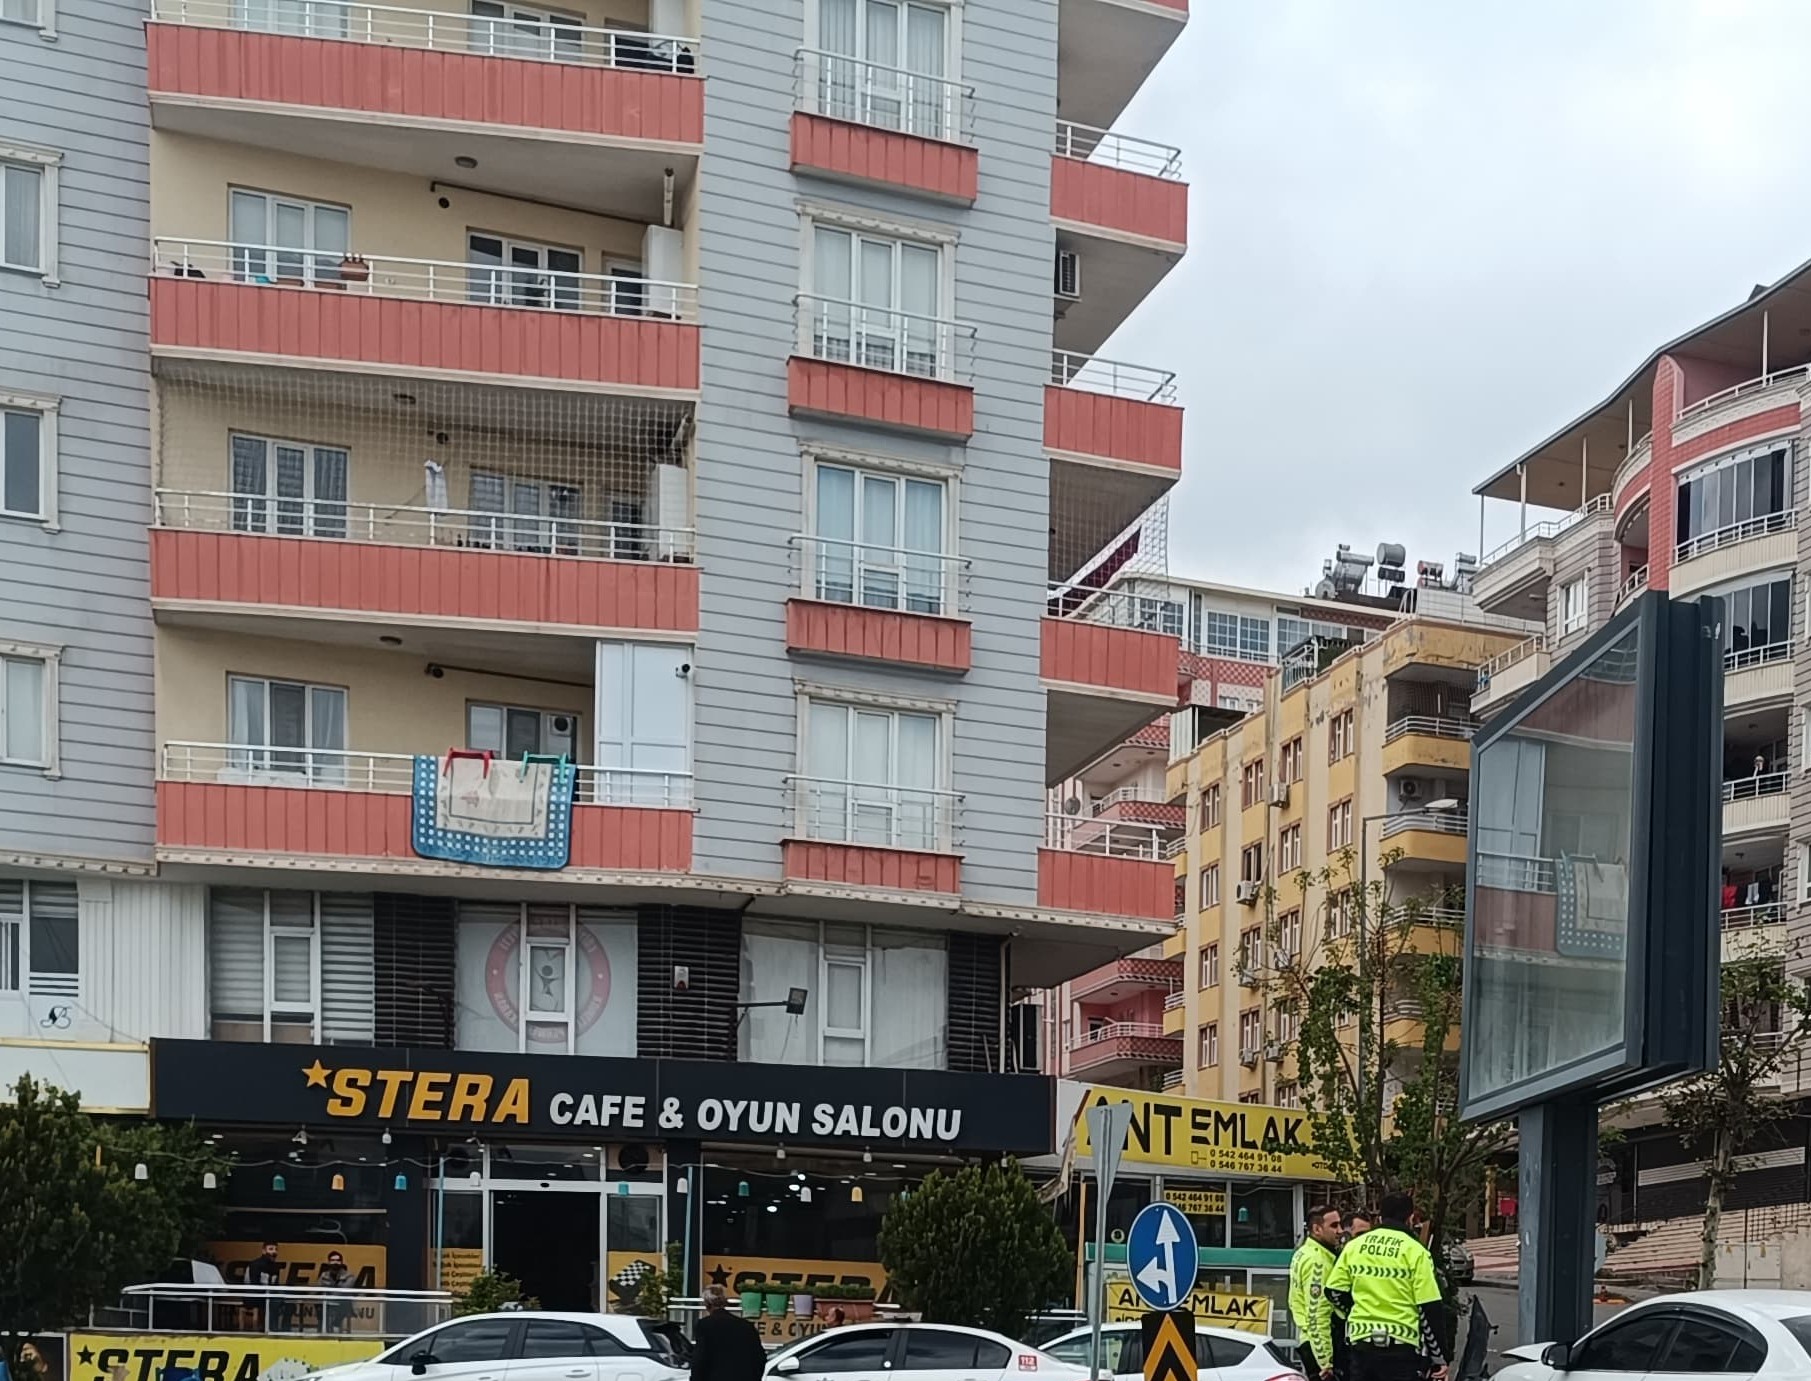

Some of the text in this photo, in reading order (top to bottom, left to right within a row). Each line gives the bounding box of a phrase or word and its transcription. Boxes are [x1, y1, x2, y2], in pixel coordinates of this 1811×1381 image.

[326, 1069, 962, 1140] STERA CAFE & OYUN SALONU
[1191, 1107, 1304, 1150] EMLAK
[1210, 1149, 1216, 1158] 0
[1219, 1150, 1236, 1160] 542
[1238, 1152, 1255, 1161] 464
[1257, 1153, 1268, 1162] 91
[1210, 1160, 1216, 1169] 0
[1219, 1161, 1236, 1170] 546
[1238, 1162, 1255, 1171] 767
[1271, 1164, 1282, 1173] 44
[1365, 1235, 1404, 1247] TRAFİK
[1186, 1294, 1259, 1317] MLAK
[1020, 1356, 1035, 1365] 112
